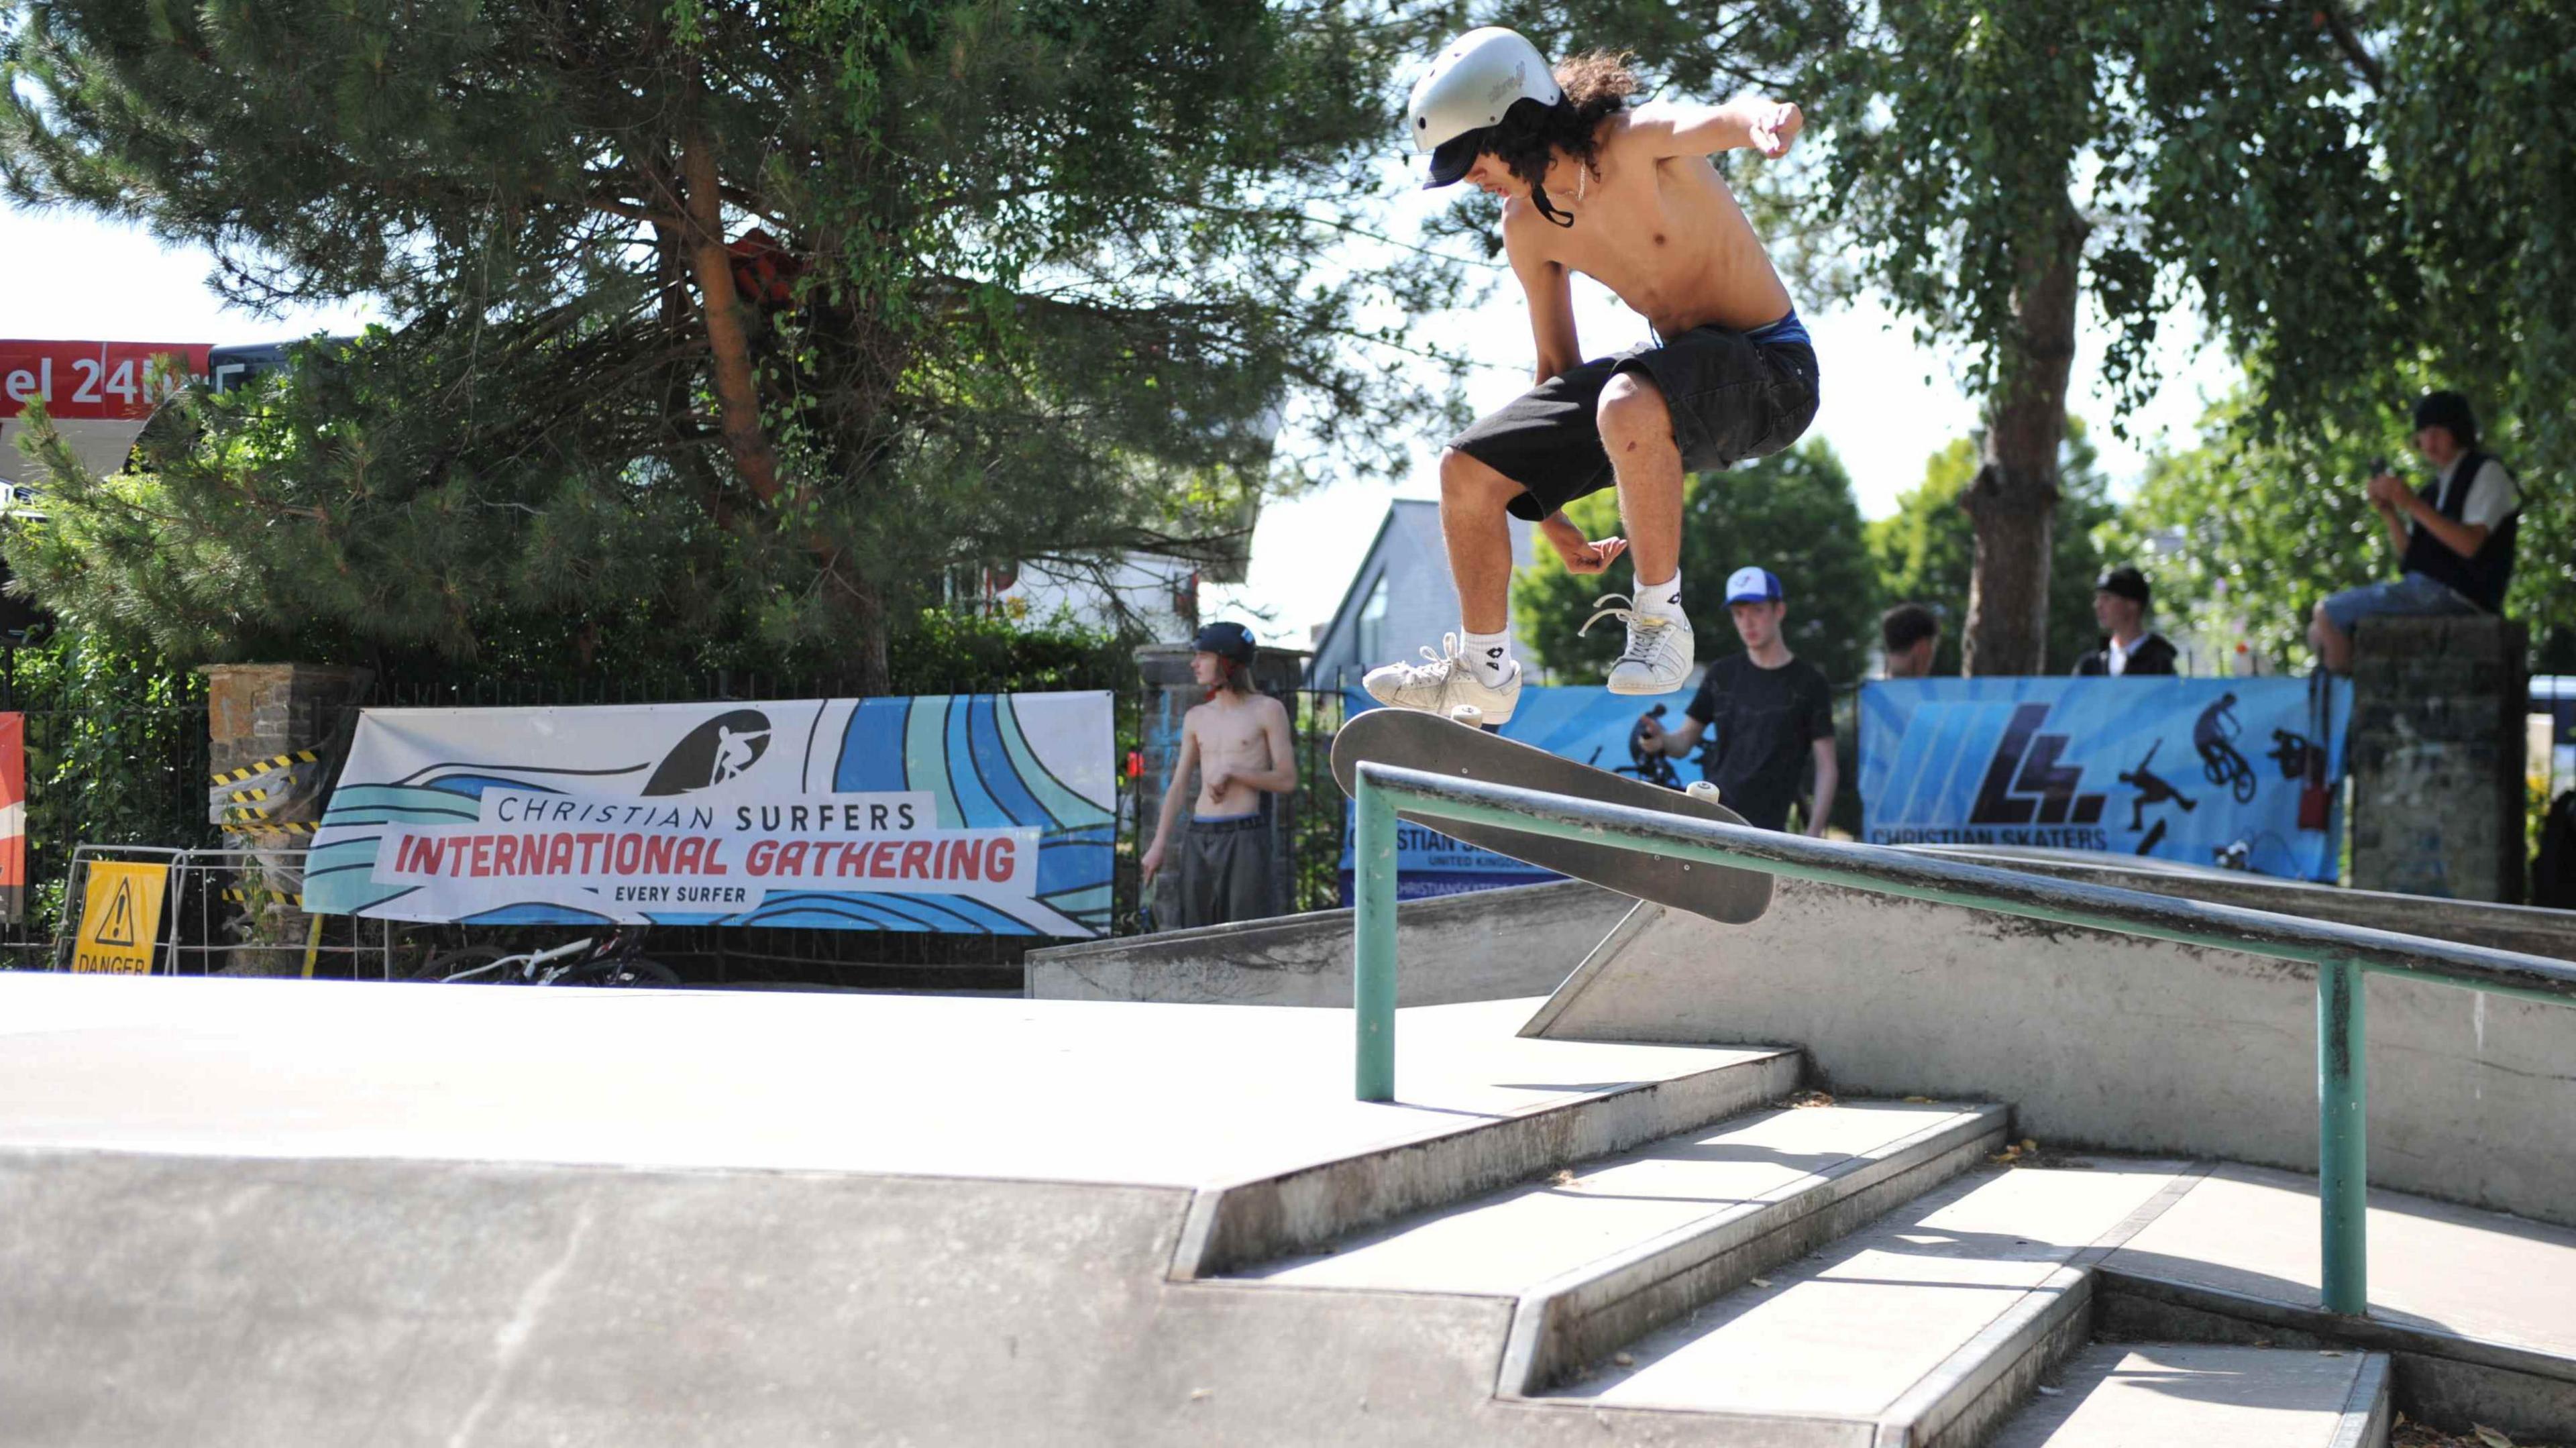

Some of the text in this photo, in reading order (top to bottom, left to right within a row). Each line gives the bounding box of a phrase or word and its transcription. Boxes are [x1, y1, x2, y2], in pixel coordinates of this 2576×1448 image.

[0, 357, 52, 402] el
[498, 797, 916, 832] CHRISTIAN SURFERS
[1872, 828, 2108, 850] CHRISTIAN SKATERS
[394, 832, 1016, 883] INTERNATIONAL GATHERING
[1428, 856, 1472, 867] UNITED
[615, 886, 746, 903] EVERY SURFER
[78, 954, 145, 975] DANGER
